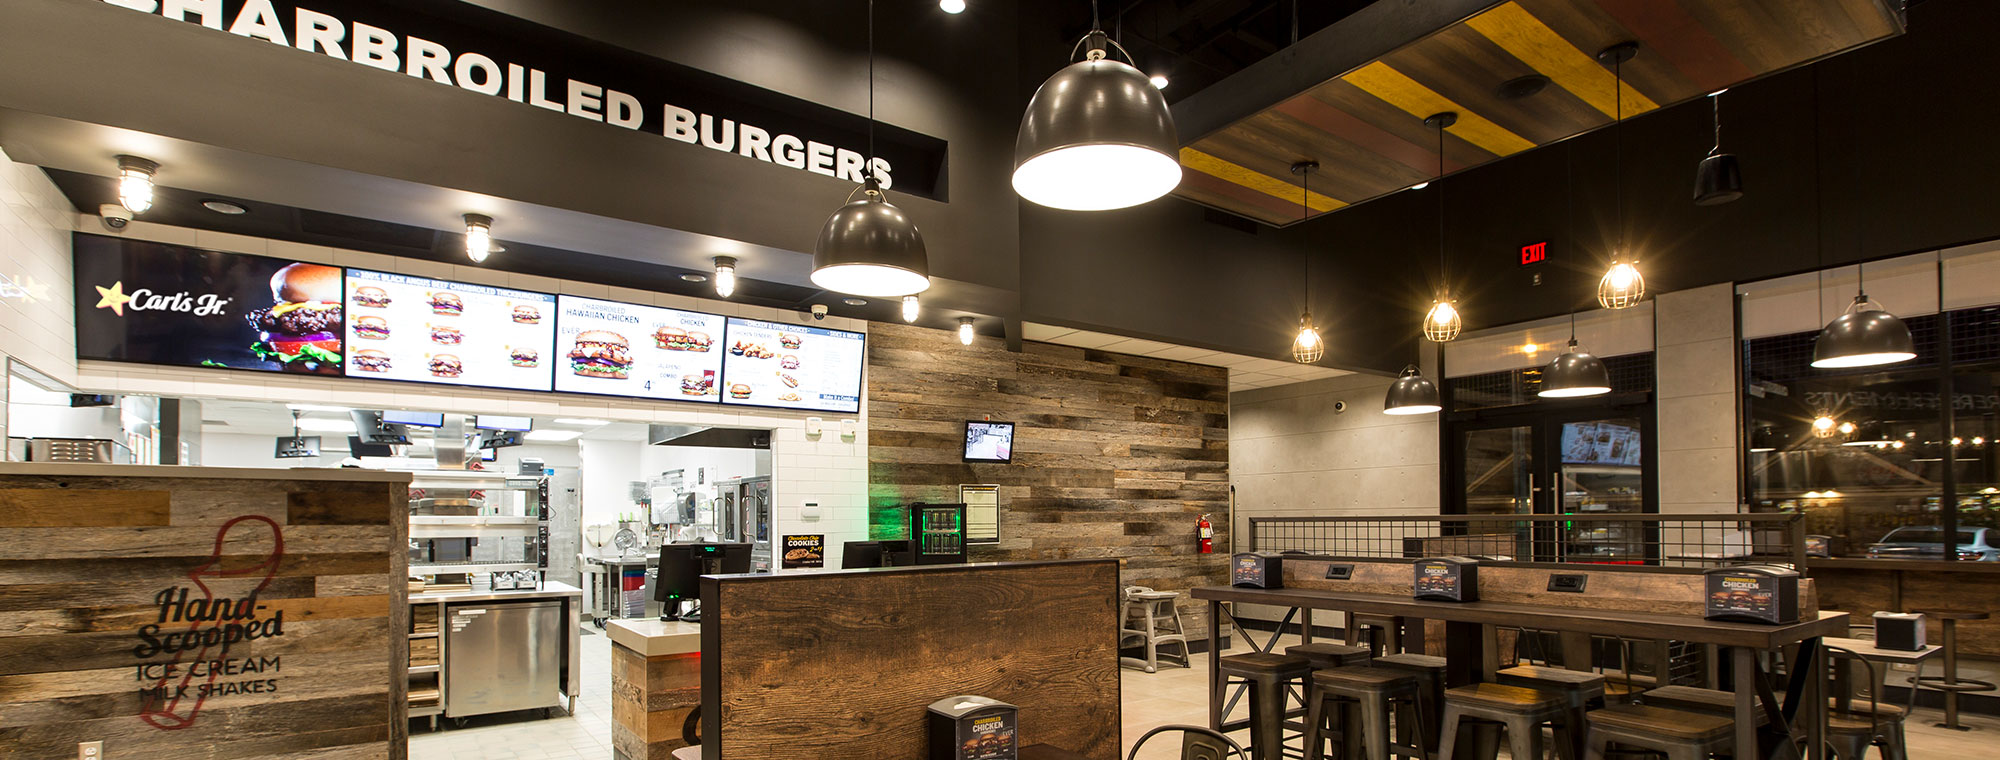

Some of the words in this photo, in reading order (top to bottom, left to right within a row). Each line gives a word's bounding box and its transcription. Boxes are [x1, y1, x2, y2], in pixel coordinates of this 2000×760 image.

[662, 103, 893, 192] BURGERS
[1521, 241, 1547, 265] EXIT
[128, 287, 193, 313] Carl's
[192, 292, 227, 317] Jr.
[566, 308, 605, 321] HAWAIIAN
[606, 313, 640, 325] CHICKEN
[680, 318, 706, 327] CHICKEN
[1722, 580, 1760, 589] CHICKEN
[156, 585, 267, 624] Hand-
[133, 610, 284, 660] Scooped
[136, 662, 179, 682] ICE
[189, 656, 281, 678] CREAM
[139, 684, 189, 703] MILK
[197, 678, 278, 699] SHAKES
[972, 720, 1004, 733] CHICKEN
